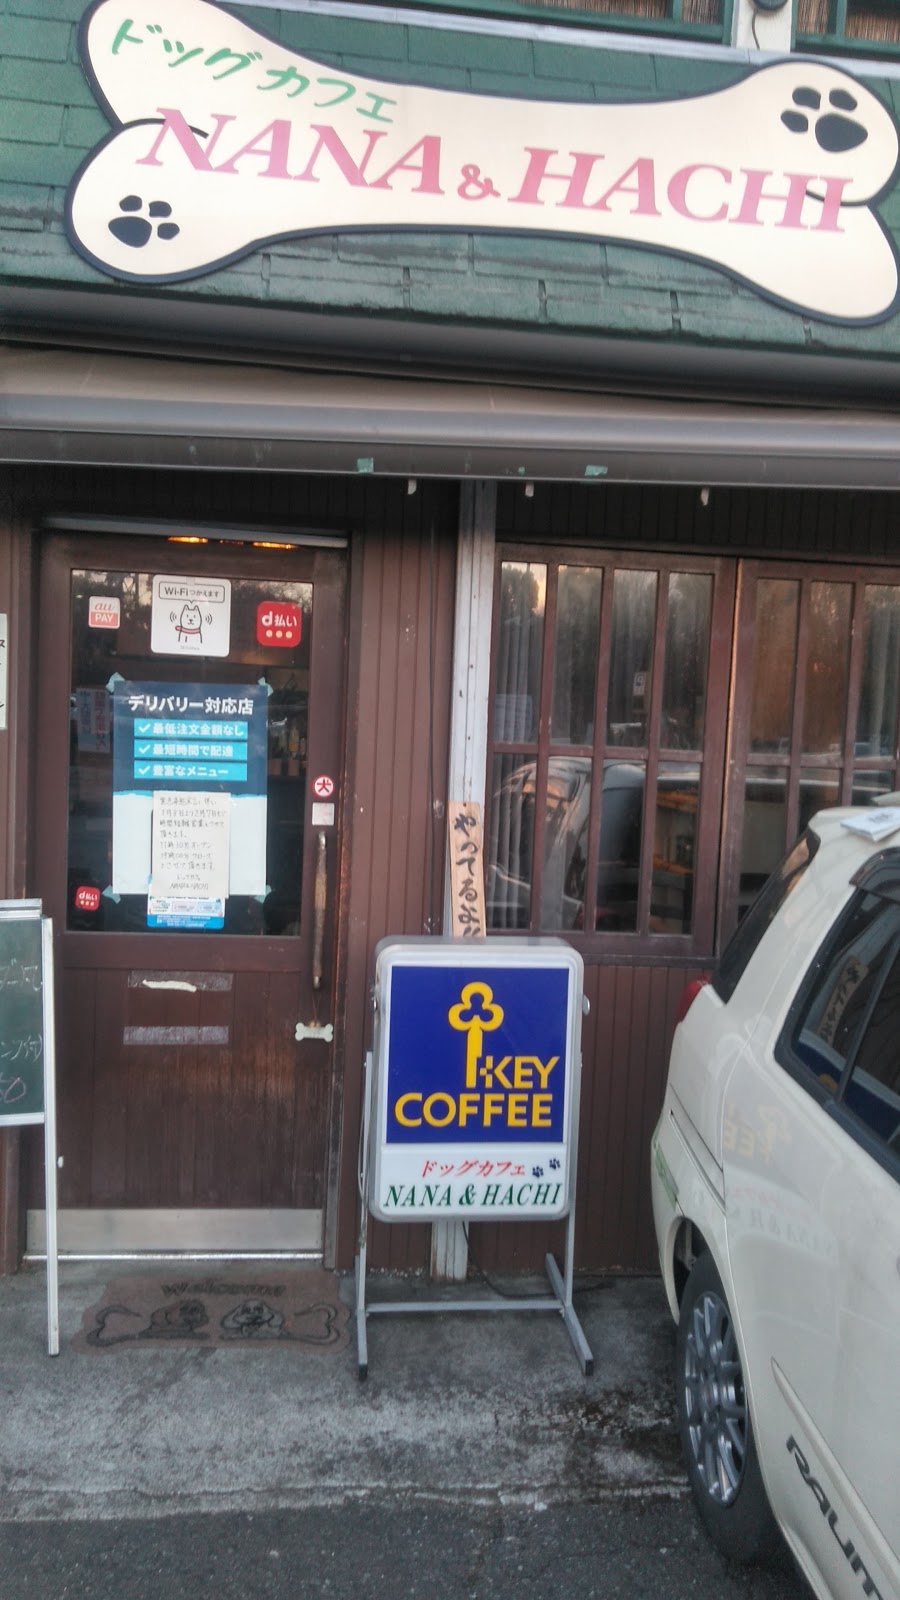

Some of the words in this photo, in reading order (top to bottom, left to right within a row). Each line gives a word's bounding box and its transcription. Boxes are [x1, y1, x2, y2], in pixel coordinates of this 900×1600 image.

[135, 107, 445, 196] NANA
[456, 164, 500, 201] &
[507, 146, 853, 233] HACHI
[94, 613, 114, 623] PAY
[128, 694, 254, 715] デリバリー対応店
[152, 723, 244, 736] 最低注文金額なし
[152, 744, 233, 757] 最短時間で配達
[152, 764, 229, 777] 豊富なメニュー
[479, 1055, 560, 1089] KEY
[394, 1092, 553, 1128] COFFEE
[421, 1159, 526, 1178] ドッグカフェ
[384, 1185, 451, 1207] NANA
[458, 1183, 477, 1206] &
[480, 1183, 563, 1205] HACHI
